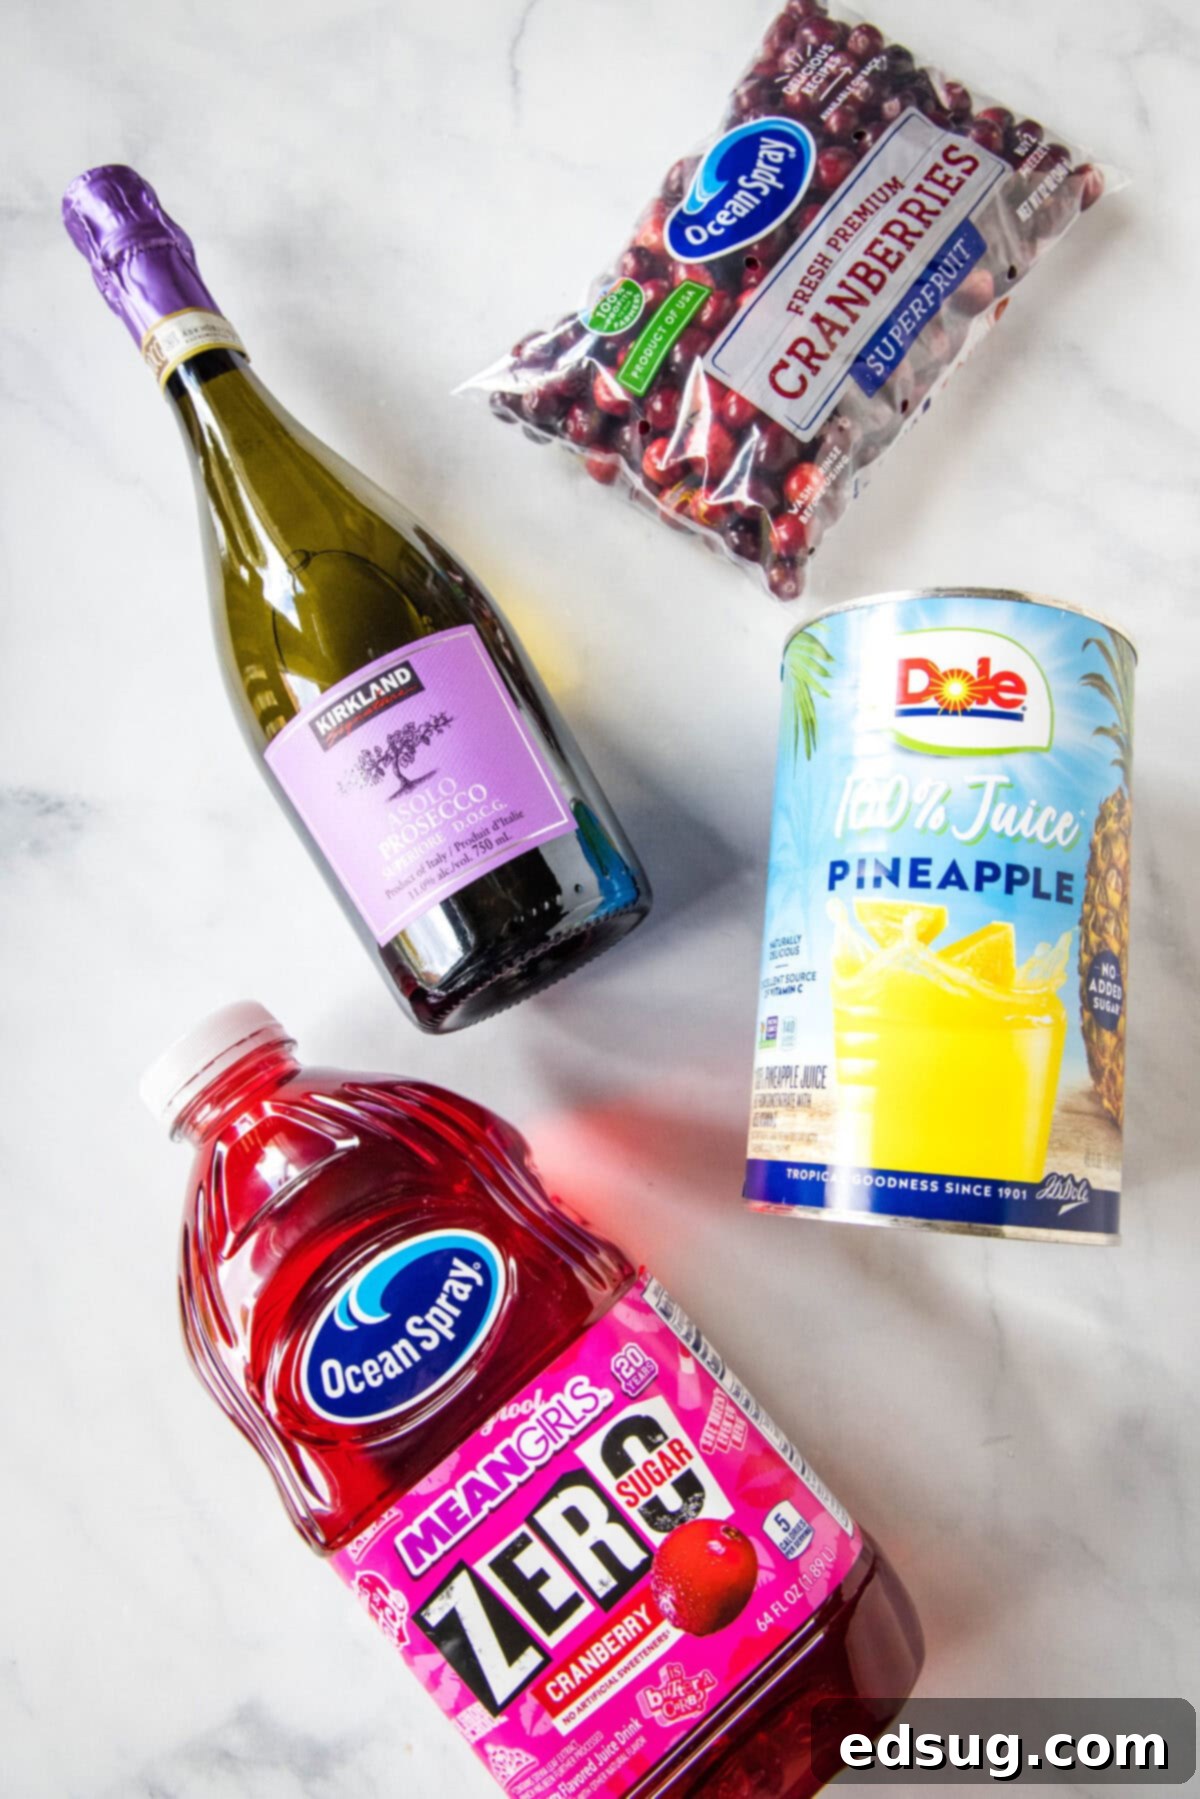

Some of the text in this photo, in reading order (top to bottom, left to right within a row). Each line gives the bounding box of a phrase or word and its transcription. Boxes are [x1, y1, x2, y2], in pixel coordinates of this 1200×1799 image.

[781, 43, 835, 96] DELICIOUS
[800, 55, 842, 96] RECIPES
[684, 136, 797, 246] Ocean Spray
[786, 175, 906, 318] FRESH PREMIUM
[768, 143, 981, 400] CRANBERRIES
[866, 238, 972, 377] SUPERFRUIT
[631, 289, 697, 379] PRODUCT OF USA
[823, 454, 850, 487] USING
[788, 484, 815, 515] WASH
[315, 667, 412, 736] KIRKLAND
[896, 657, 1028, 711] Dole
[378, 784, 487, 859] PROSECCO
[389, 777, 457, 824] ASOLO
[452, 800, 508, 832] D.O.C.G.
[833, 774, 1081, 847] 100% Juice
[385, 874, 416, 900] Product
[416, 865, 427, 879] of
[425, 850, 448, 871] Italy
[454, 826, 491, 853] Produit
[492, 809, 525, 832] d'Italie
[471, 838, 494, 858] 750
[828, 857, 1075, 905] PINEAPPLE
[785, 971, 817, 984] SOURCE
[1088, 978, 1122, 1000] ADDED
[1101, 962, 1116, 980] NO
[1093, 996, 1120, 1016] SUGAR
[800, 1064, 829, 1090] JUICE
[786, 1167, 1028, 1200] TROPICA GOODNESS SINCE 1901
[320, 1256, 484, 1399] Ocean Spray
[615, 1344, 644, 1381] 20
[626, 1360, 656, 1392] YEARS
[400, 1380, 600, 1571] MEAN GIRLS
[615, 1437, 694, 1509] SUGAR
[773, 1511, 791, 1533] 5
[779, 1518, 807, 1551] CALORIES
[420, 1414, 706, 1709] ZERO
[755, 1611, 775, 1633] 64
[770, 1600, 789, 1618] FL
[783, 1583, 804, 1605] OZ
[798, 1557, 826, 1591] (1.89
[545, 1602, 653, 1703] CRANBERRY
[562, 1711, 577, 1726] NO
[576, 1677, 620, 1718] ARTIFICIAL
[550, 1754, 577, 1779] FURTHER
[571, 1730, 605, 1761] PROCESSED
[556, 1715, 644, 1798] Flavored Juice Drink
[623, 1734, 647, 1757] FLAVOR
